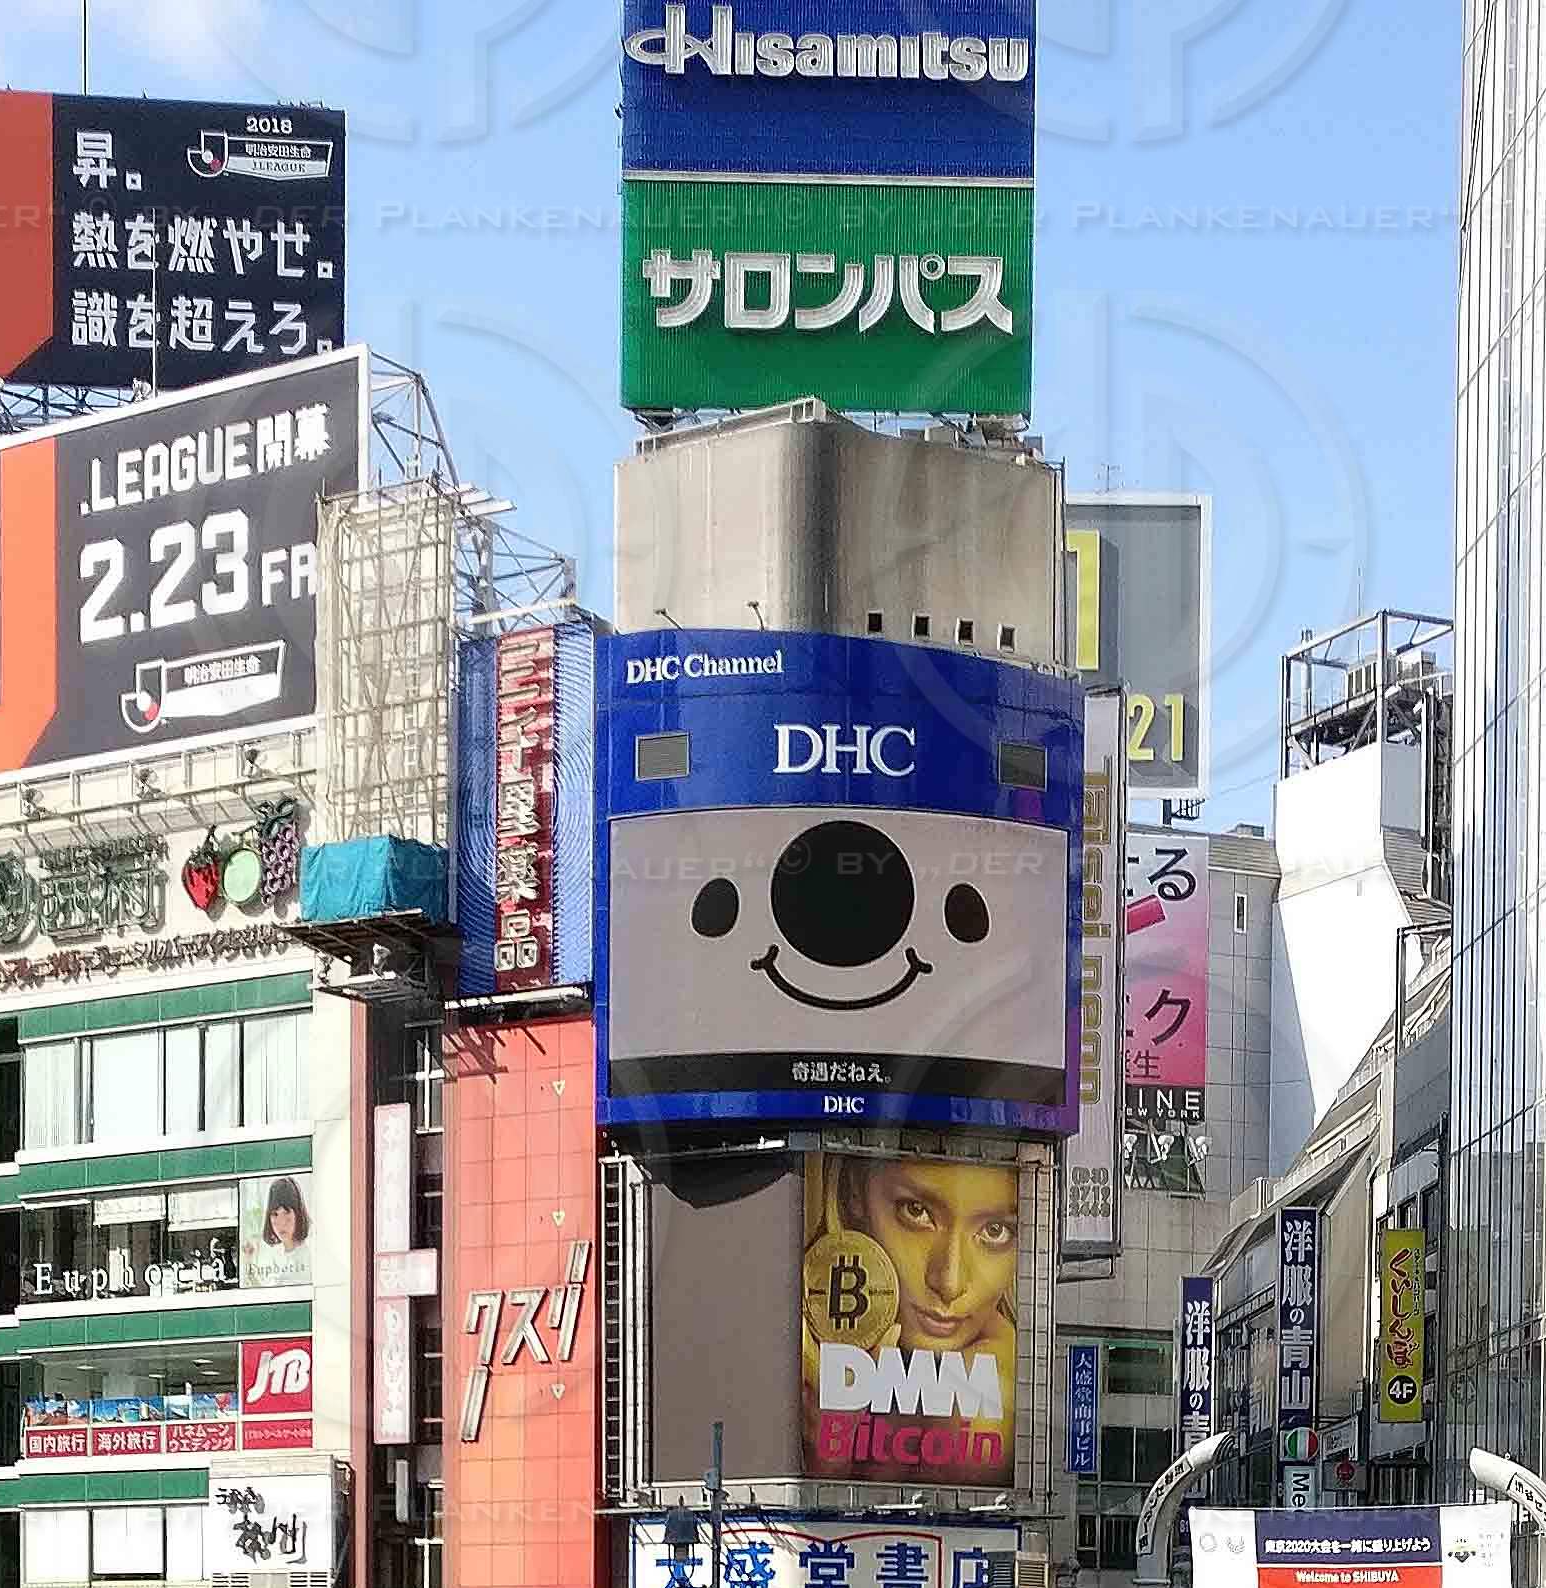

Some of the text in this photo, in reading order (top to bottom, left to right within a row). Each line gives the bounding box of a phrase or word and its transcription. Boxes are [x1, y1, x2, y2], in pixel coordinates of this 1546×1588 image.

[624, 4, 1029, 81] Hisamitsu
[245, 115, 293, 136] 2018
[72, 211, 335, 281] 熱を燃やせ。
[642, 249, 1013, 334] サロンパス
[71, 290, 333, 355] 識を超えろ。
[79, 508, 250, 645] 2.23
[625, 649, 784, 685] DHC Channel
[772, 723, 916, 777] DHC
[791, 1061, 894, 1086] 奇遇だねえ。
[822, 1094, 866, 1115] DHC
[33, 1247, 226, 1298] Euphoria
[1281, 1219, 1314, 1410] 洋服の青山
[246, 1348, 312, 1404] JTB
[818, 1342, 1003, 1418] DMM
[1389, 1381, 1414, 1401] 4F
[28, 1433, 88, 1454] 国内旅行
[97, 1430, 158, 1452] 海外旅行
[817, 1409, 1004, 1468] Bitcoin
[1295, 1569, 1401, 1585] Welcome to SHIBUYA
